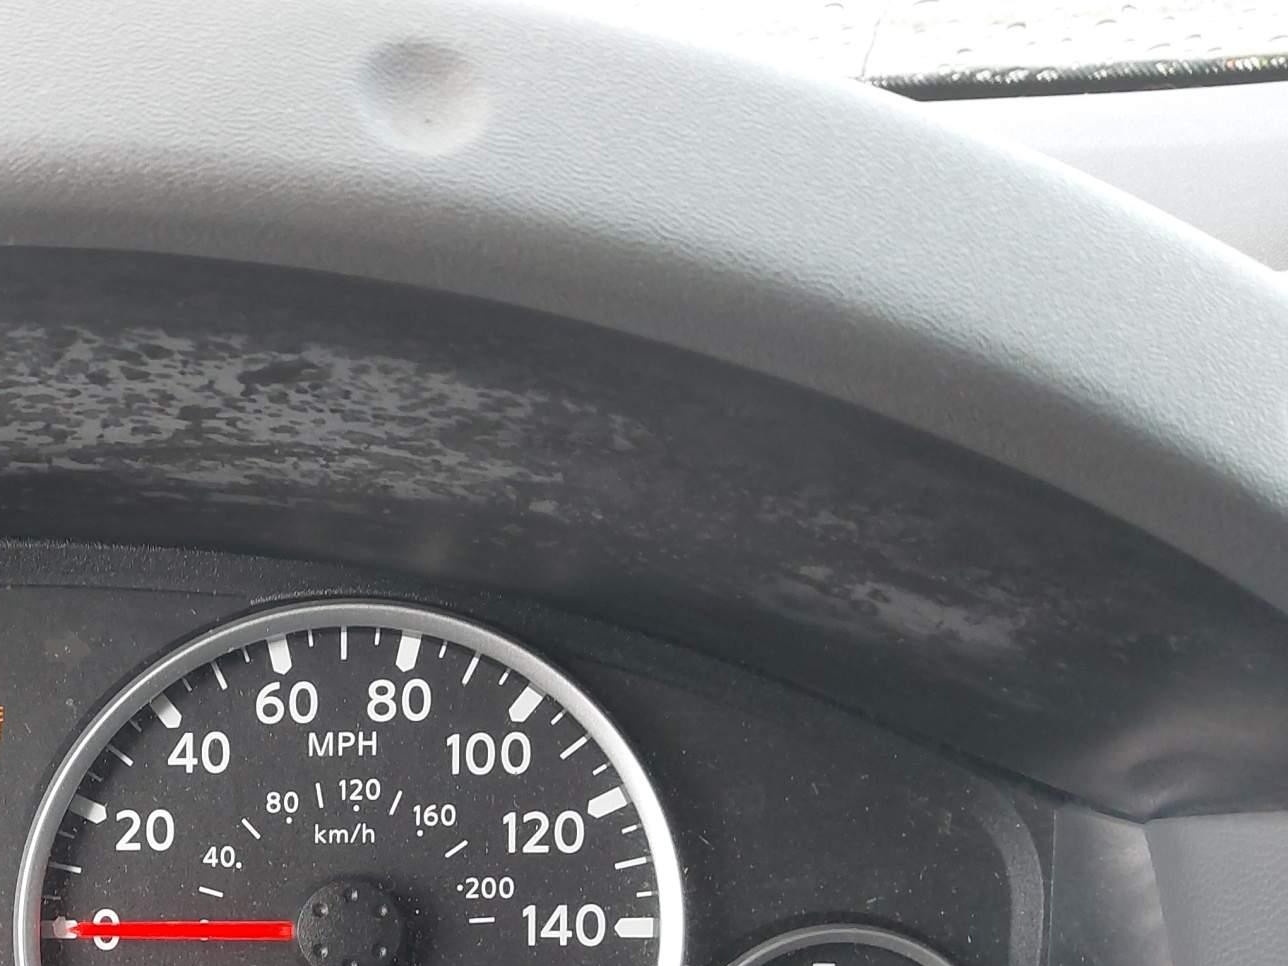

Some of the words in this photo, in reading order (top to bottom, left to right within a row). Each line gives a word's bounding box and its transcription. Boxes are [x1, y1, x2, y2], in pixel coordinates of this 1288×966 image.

[255, 689, 318, 725] 60
[366, 678, 432, 722] 80
[167, 731, 231, 774] 40
[308, 731, 377, 757] MPH
[446, 731, 531, 776] 100
[266, 791, 299, 814] 80
[338, 778, 381, 801] 120
[115, 809, 175, 851] 20
[314, 822, 375, 844] km/h
[413, 804, 456, 827] 160
[502, 810, 585, 854] 120
[202, 846, 230, 868] 40
[465, 876, 515, 899] 200
[92, 908, 120, 951] 0
[522, 903, 606, 947] 140
